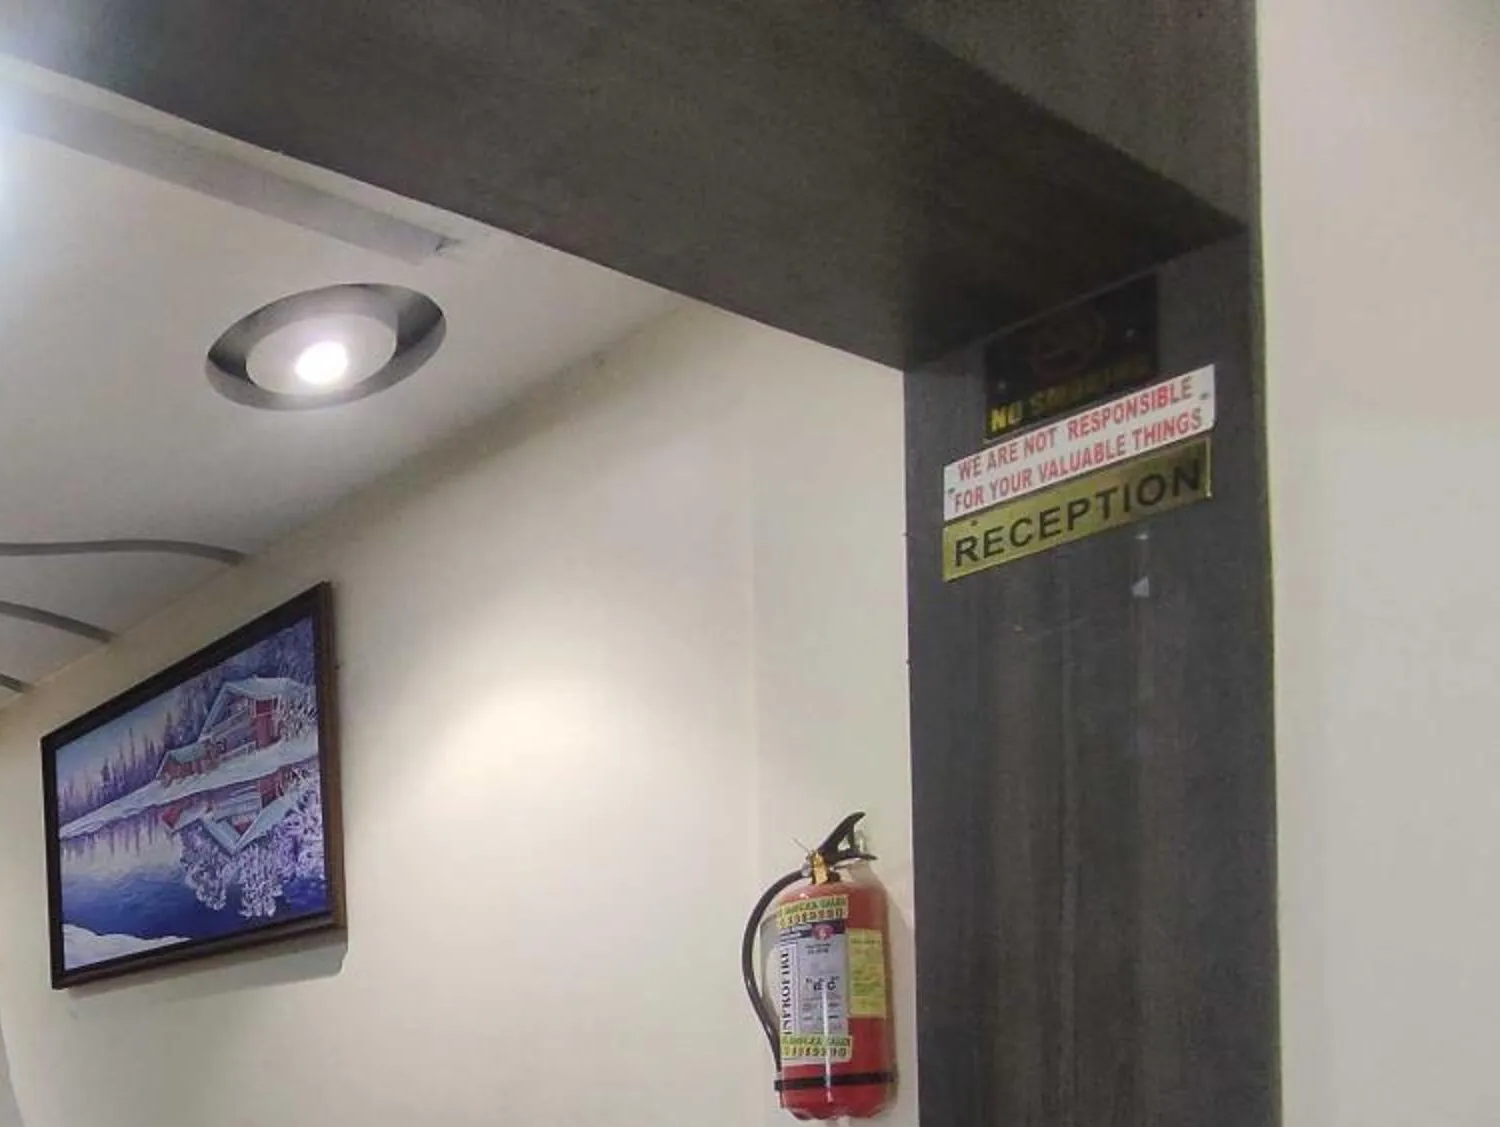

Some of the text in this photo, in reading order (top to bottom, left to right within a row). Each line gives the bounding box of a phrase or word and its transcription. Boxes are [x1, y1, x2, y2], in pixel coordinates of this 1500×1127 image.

[953, 407, 1202, 514] FOR YOUR VALUABLE THINGS
[957, 459, 982, 481] WE
[986, 442, 1018, 472] ARE
[1023, 427, 1056, 461] NOT
[1067, 375, 1193, 441] RESPONSIBLE
[954, 459, 1200, 568] RECEPTION
